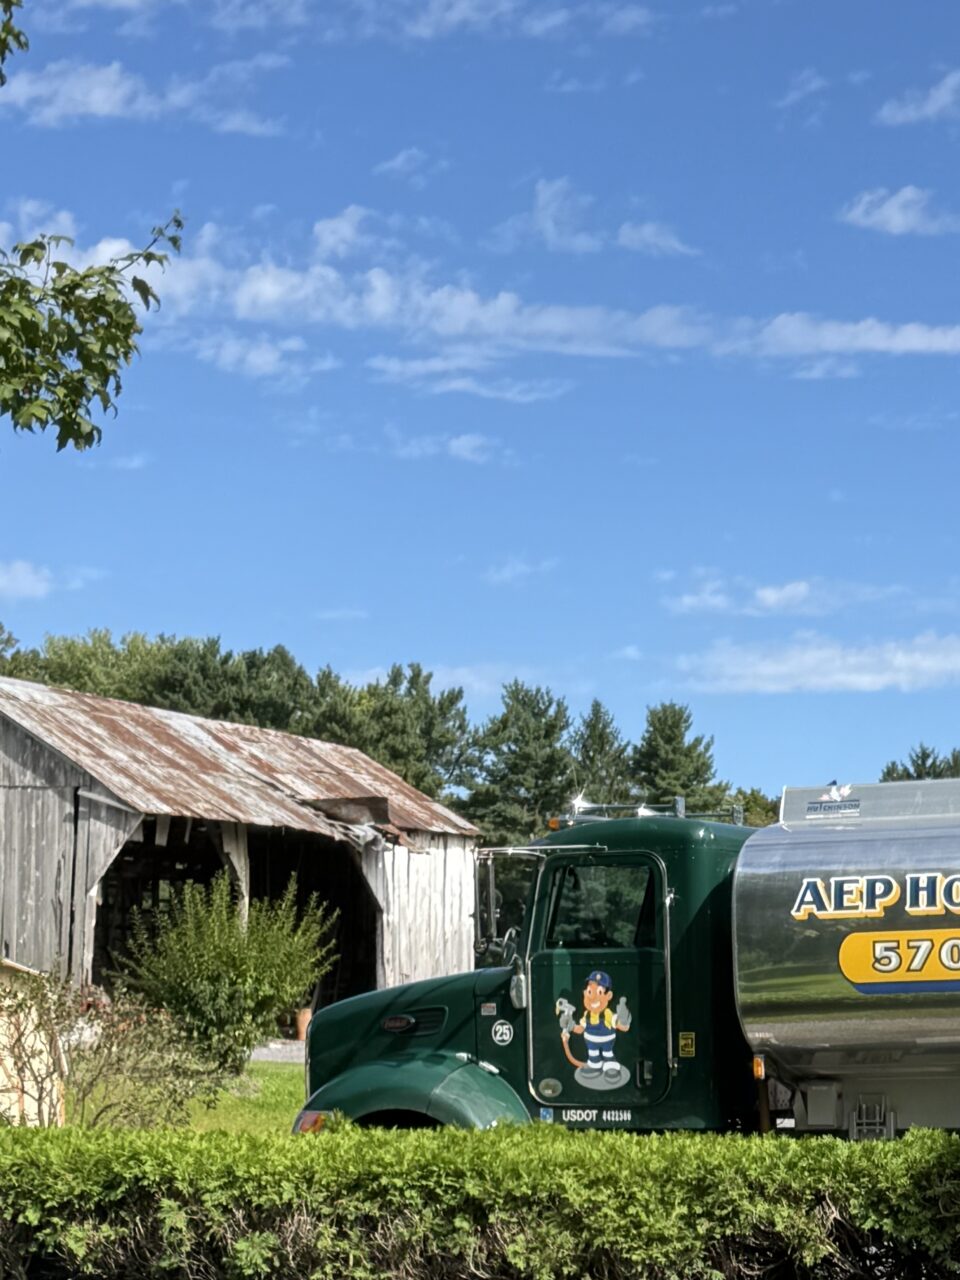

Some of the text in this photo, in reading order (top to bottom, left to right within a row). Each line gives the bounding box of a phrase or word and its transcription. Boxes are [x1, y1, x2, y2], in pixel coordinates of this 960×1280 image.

[791, 876, 900, 920] AEP
[495, 1024, 510, 1041] 25
[562, 1109, 598, 1122] USDOT
